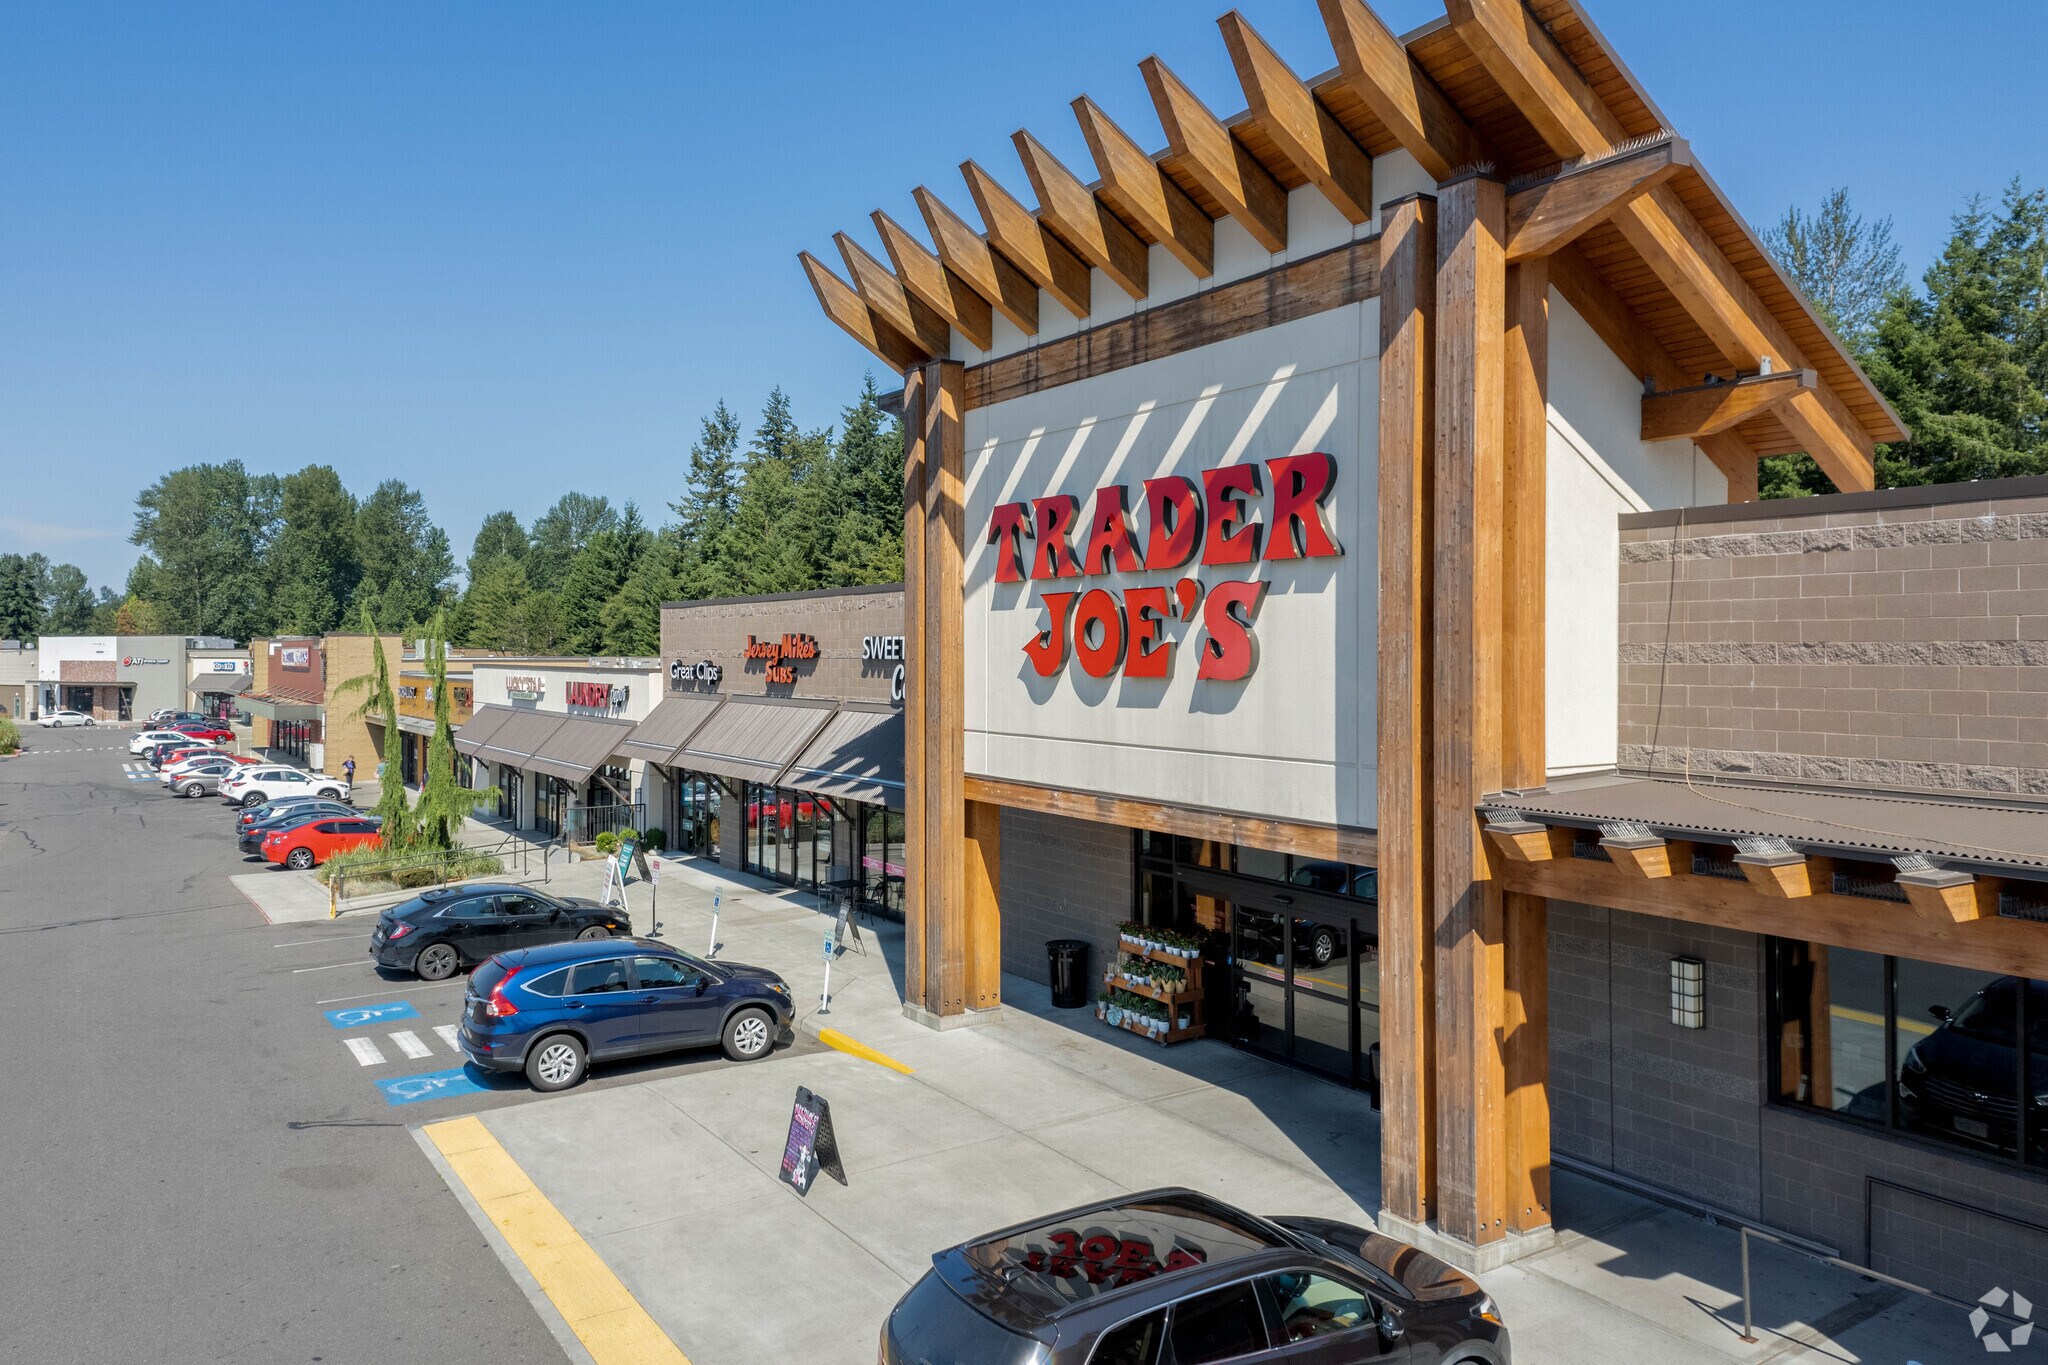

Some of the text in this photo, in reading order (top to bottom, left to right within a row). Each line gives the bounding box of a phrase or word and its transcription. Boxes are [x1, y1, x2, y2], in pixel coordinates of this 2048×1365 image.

[986, 451, 1345, 583] TRADER
[1022, 577, 1272, 682] JOE'S
[132, 657, 144, 666] ATI
[743, 632, 816, 666] Jersey Mike's
[862, 635, 905, 660] SWEET
[669, 662, 718, 686] Great Clips
[566, 681, 609, 709] LAUNDRY
